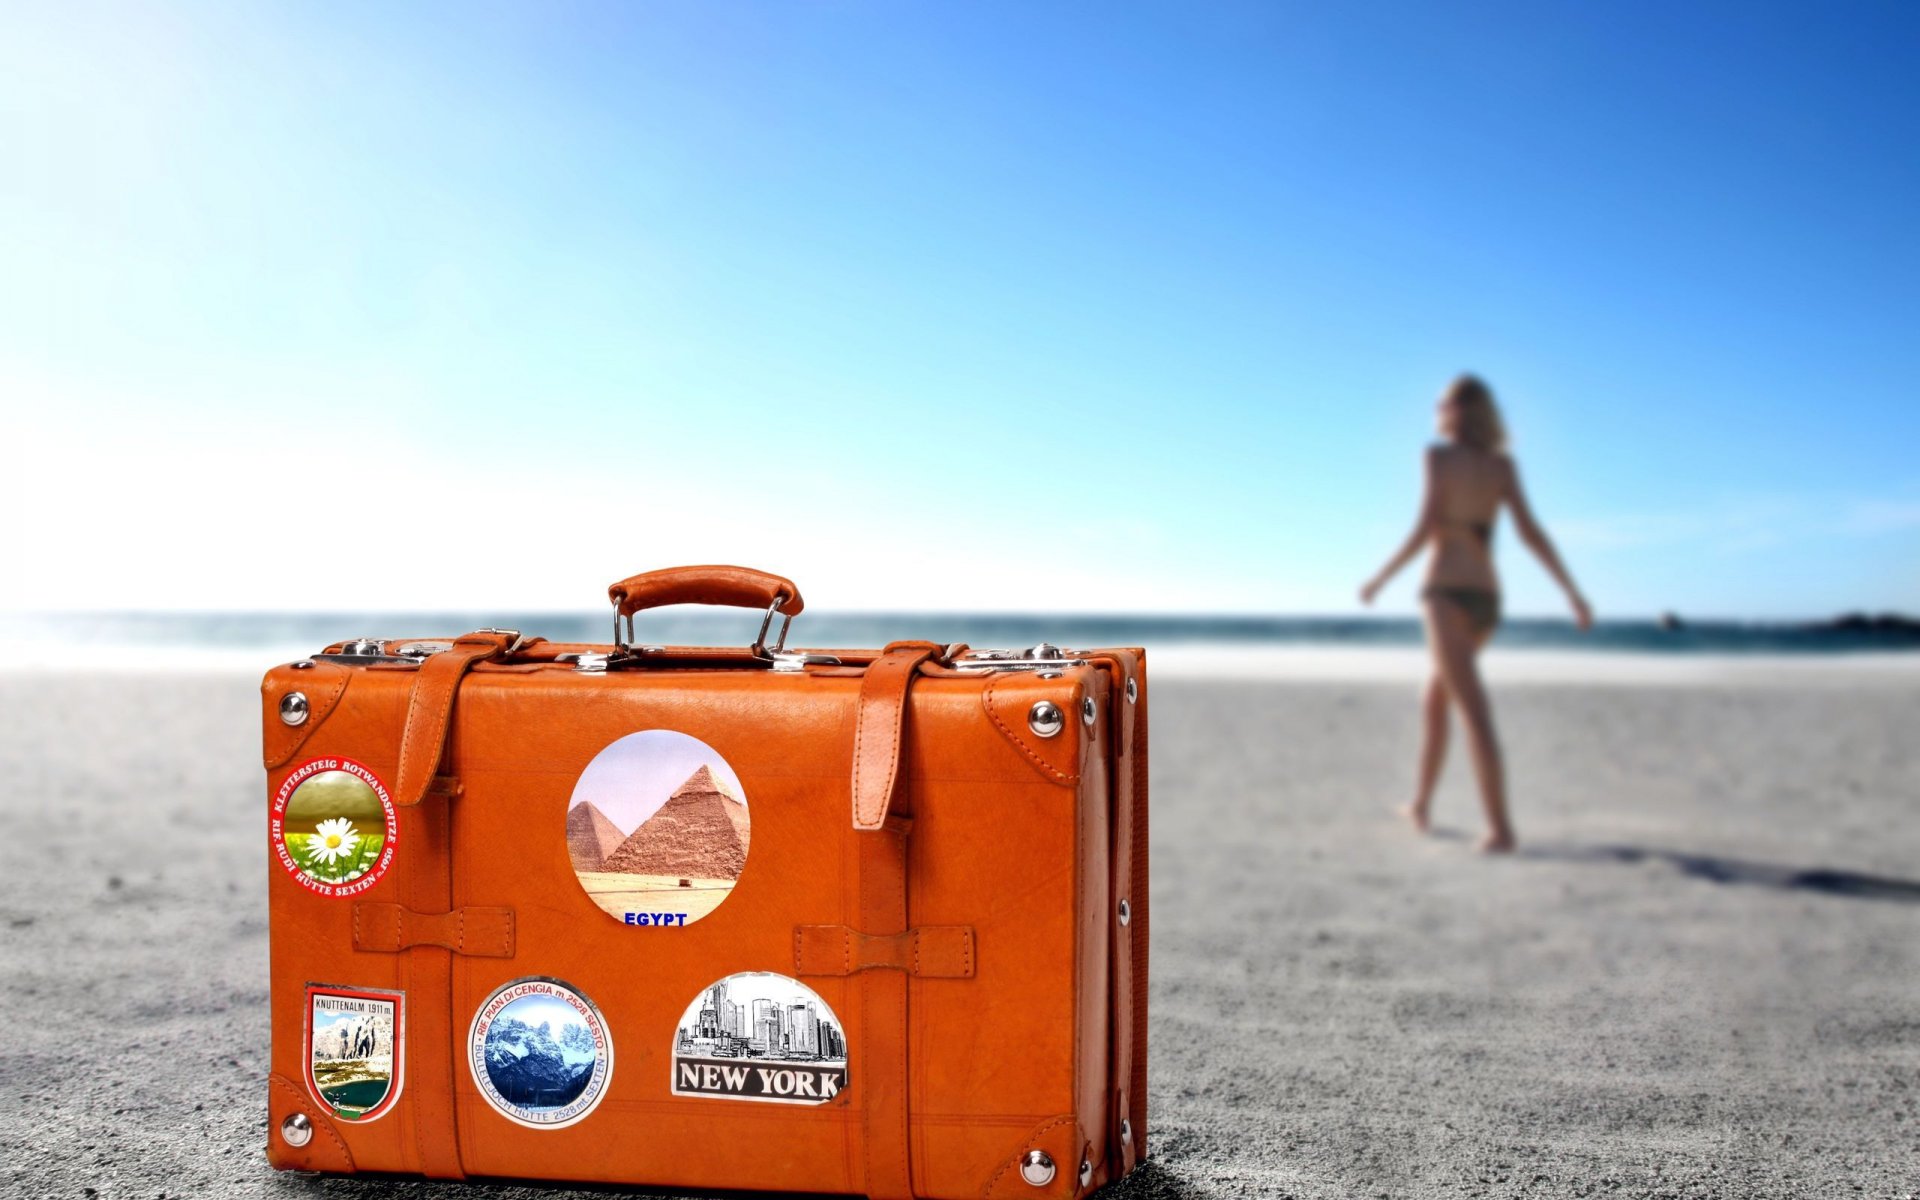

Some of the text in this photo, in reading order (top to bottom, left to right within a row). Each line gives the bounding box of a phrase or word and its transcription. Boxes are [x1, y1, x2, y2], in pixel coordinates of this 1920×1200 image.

[274, 759, 397, 843] KLETTERSTEIG ROTWANDSPITZE
[276, 842, 296, 872] RUDI
[295, 872, 332, 895] HÜTTE
[335, 874, 376, 897] SEXTEN
[624, 912, 688, 927] EGYPT
[316, 999, 364, 1012] KNUTTENALM
[484, 999, 506, 1020] PIAN
[503, 990, 515, 1000] DI
[514, 983, 553, 997] CENGIA
[584, 1014, 604, 1050] SESTO
[553, 1105, 577, 1120] 2528
[586, 1059, 605, 1097] SEXTEN
[679, 1062, 840, 1099] NEW YORK
